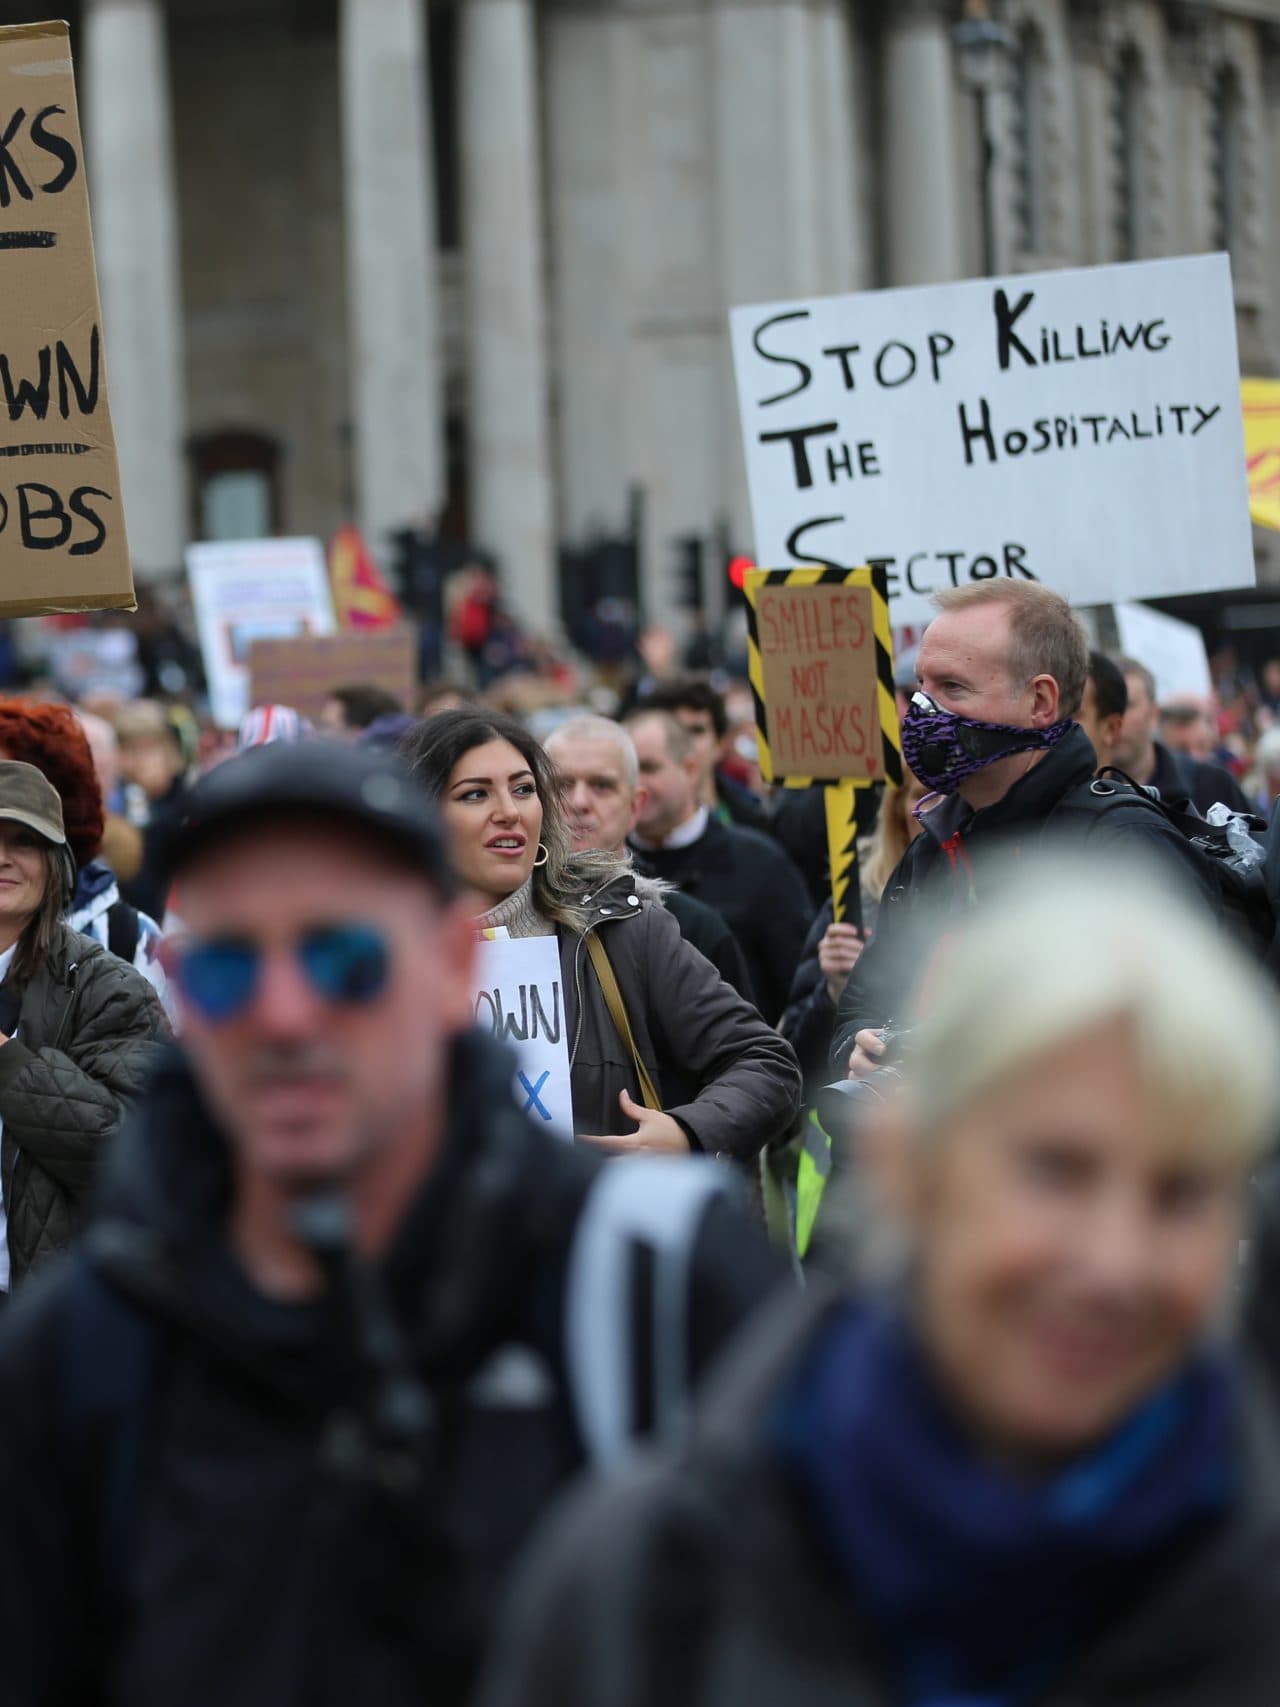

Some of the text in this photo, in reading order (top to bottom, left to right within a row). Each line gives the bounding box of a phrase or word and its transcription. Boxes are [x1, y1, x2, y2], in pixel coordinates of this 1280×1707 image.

[753, 310, 955, 407] STOP
[758, 421, 881, 490] THE
[762, 594, 866, 654] SMILES
[791, 660, 829, 699] NOT
